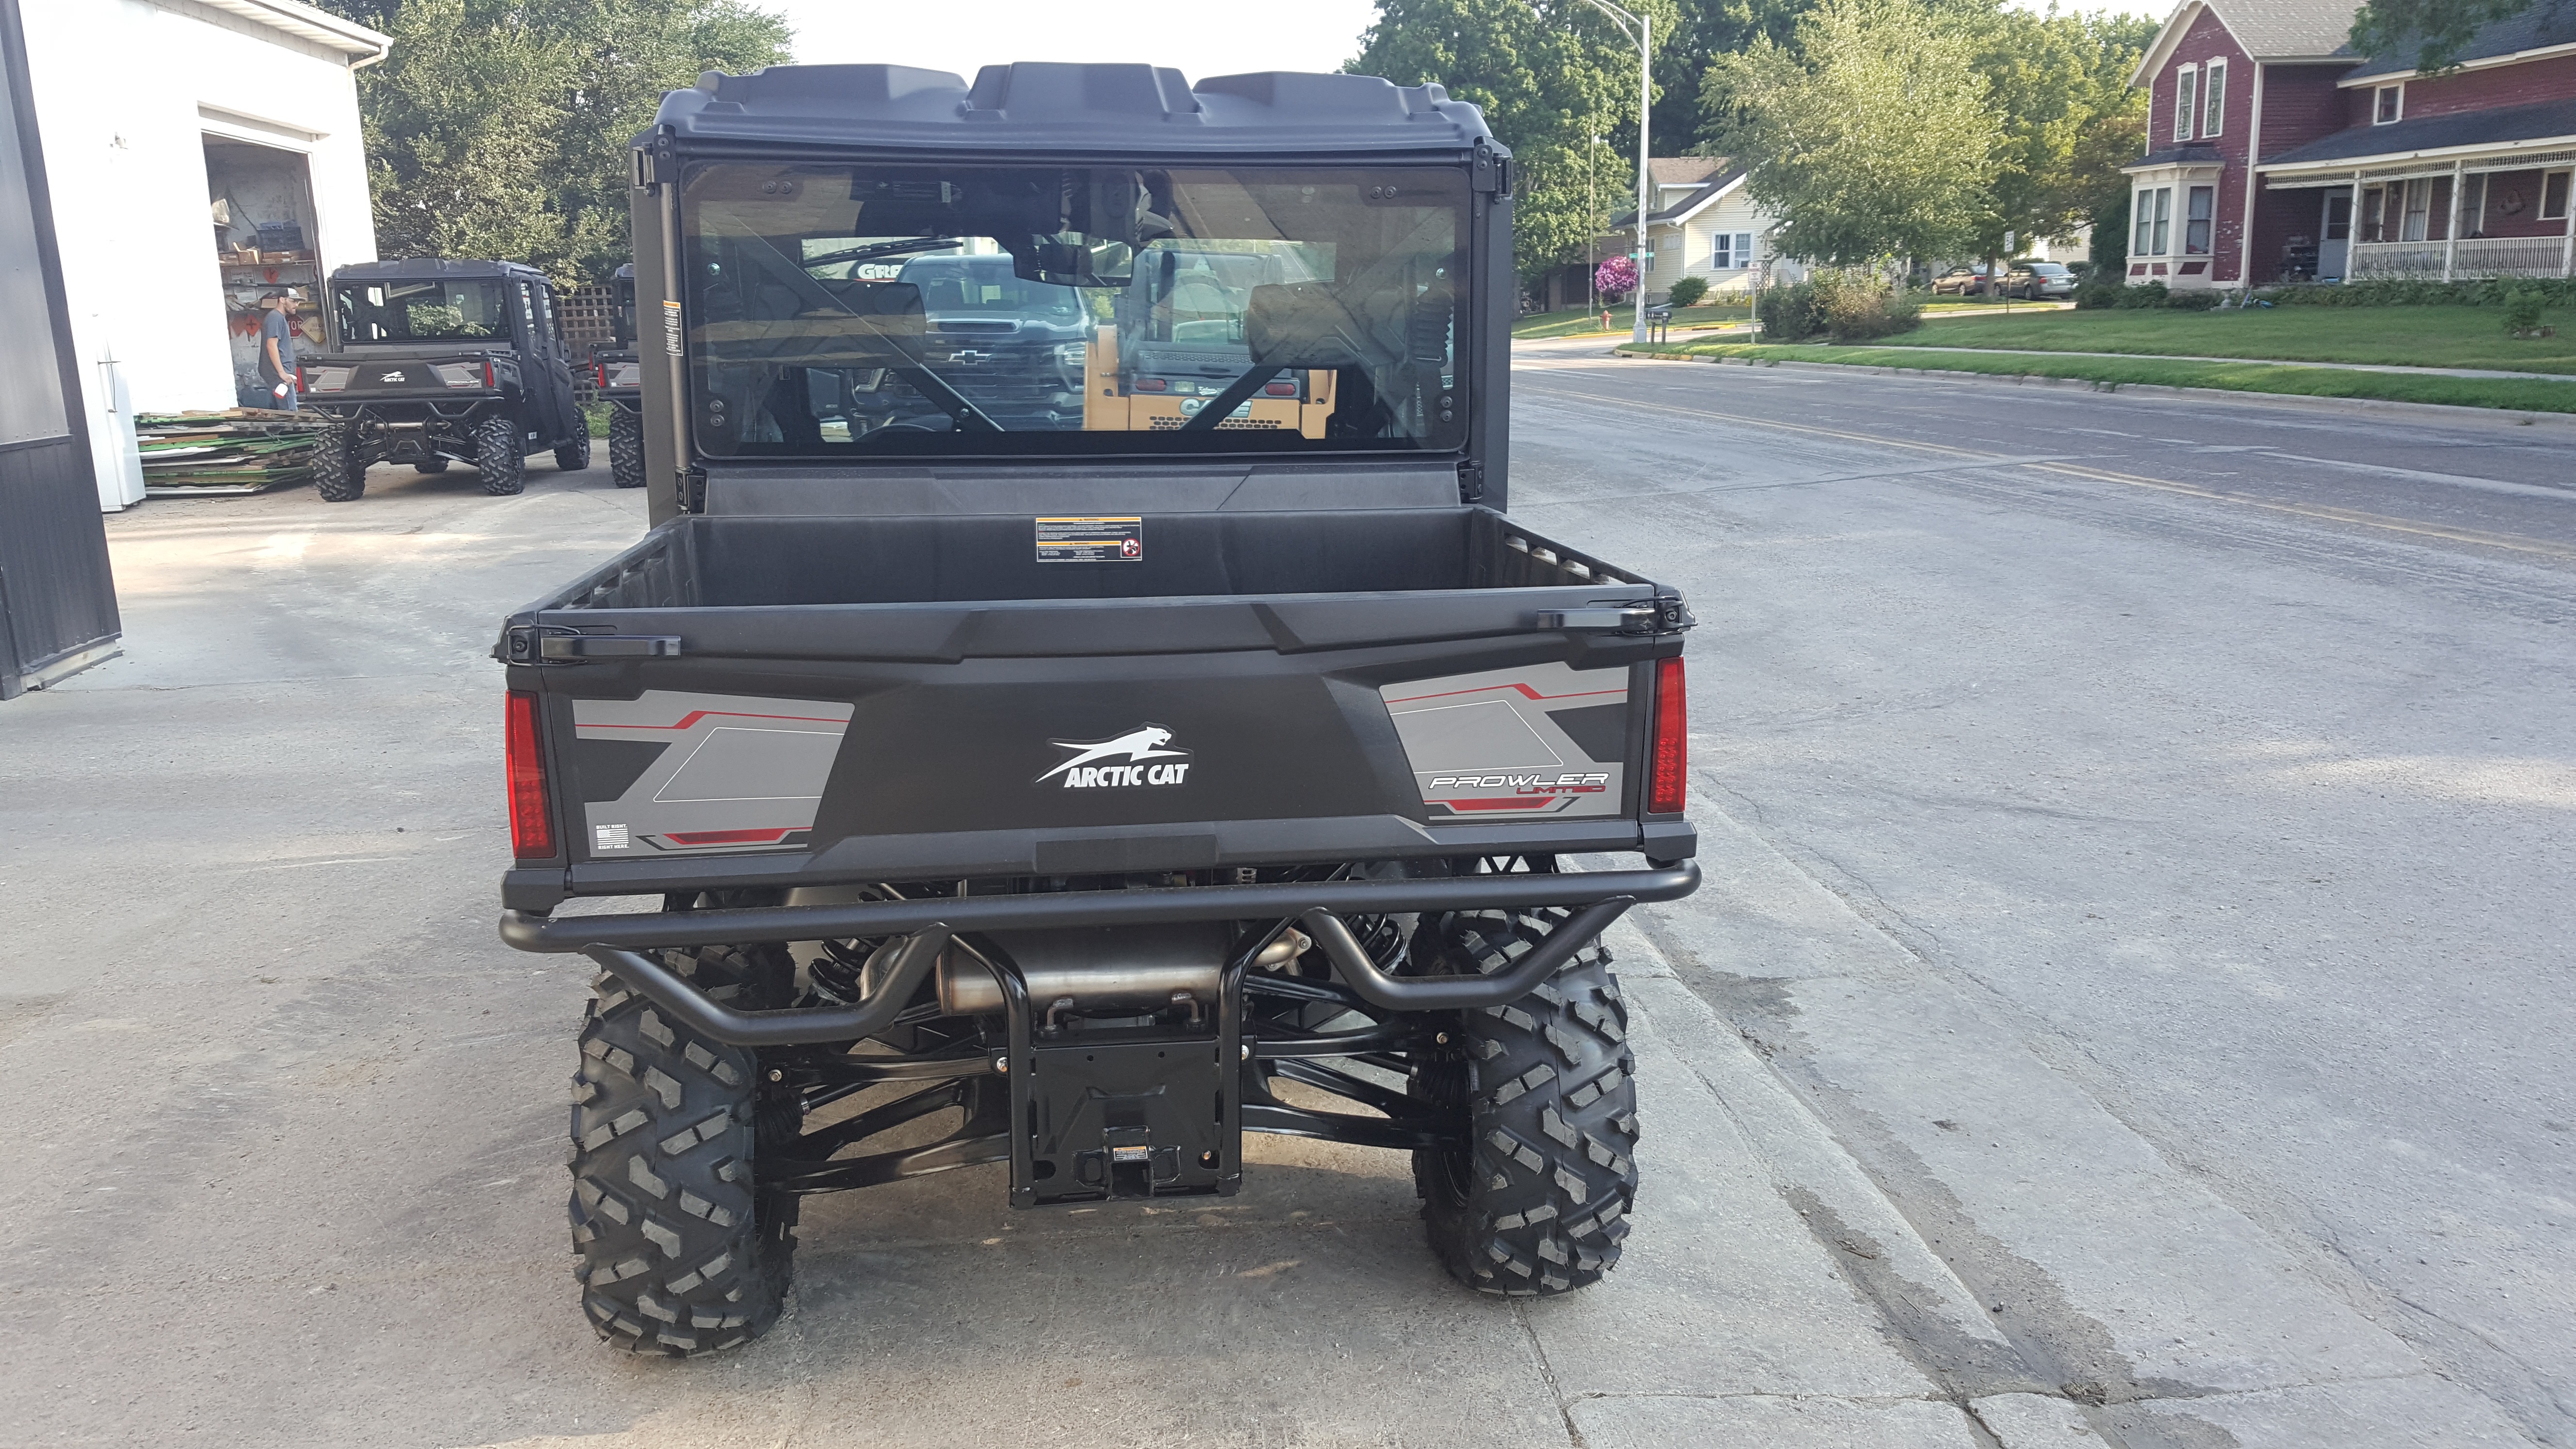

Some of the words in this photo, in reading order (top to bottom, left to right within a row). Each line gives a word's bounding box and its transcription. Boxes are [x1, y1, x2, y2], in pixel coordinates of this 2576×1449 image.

[1180, 398, 1253, 417] CE
[1063, 765, 1144, 788] ARCTIC
[1147, 764, 1189, 785] CAT
[1429, 773, 1609, 789] PROWLER
[1516, 785, 1606, 794] LIMITED
